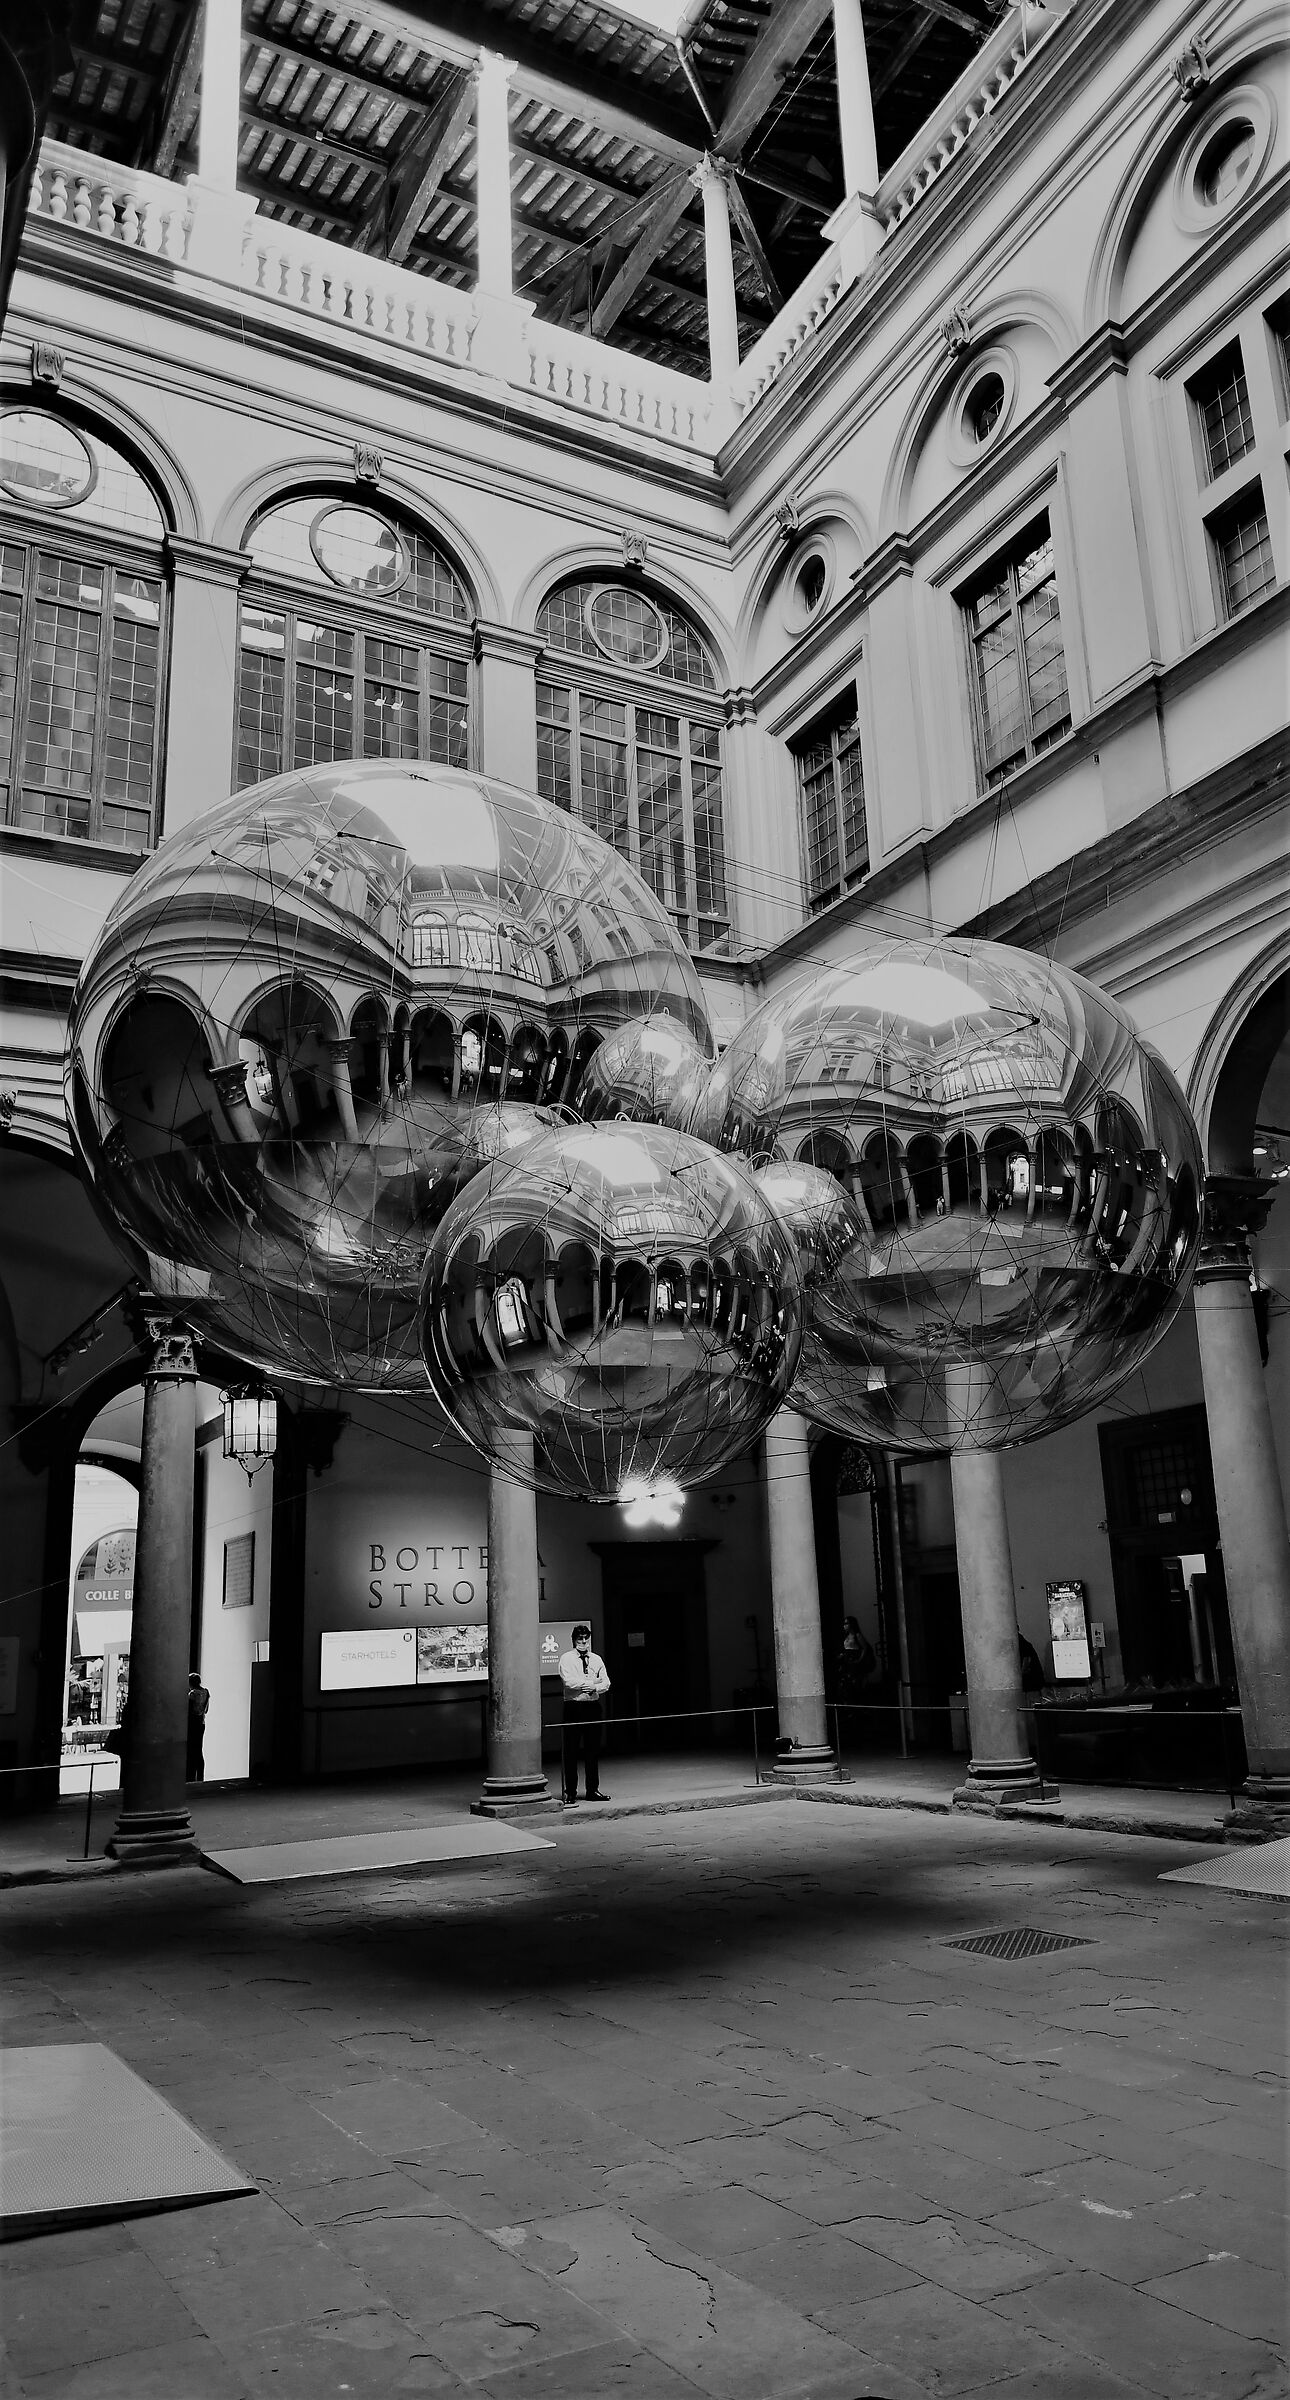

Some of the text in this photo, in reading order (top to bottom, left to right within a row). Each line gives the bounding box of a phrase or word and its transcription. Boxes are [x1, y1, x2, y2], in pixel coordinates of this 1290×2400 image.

[369, 1544, 547, 1572] BOTTE
[85, 1590, 120, 1601] COLLE
[368, 1578, 547, 1608] STROI
[341, 1650, 397, 1661] STARHOTELS
